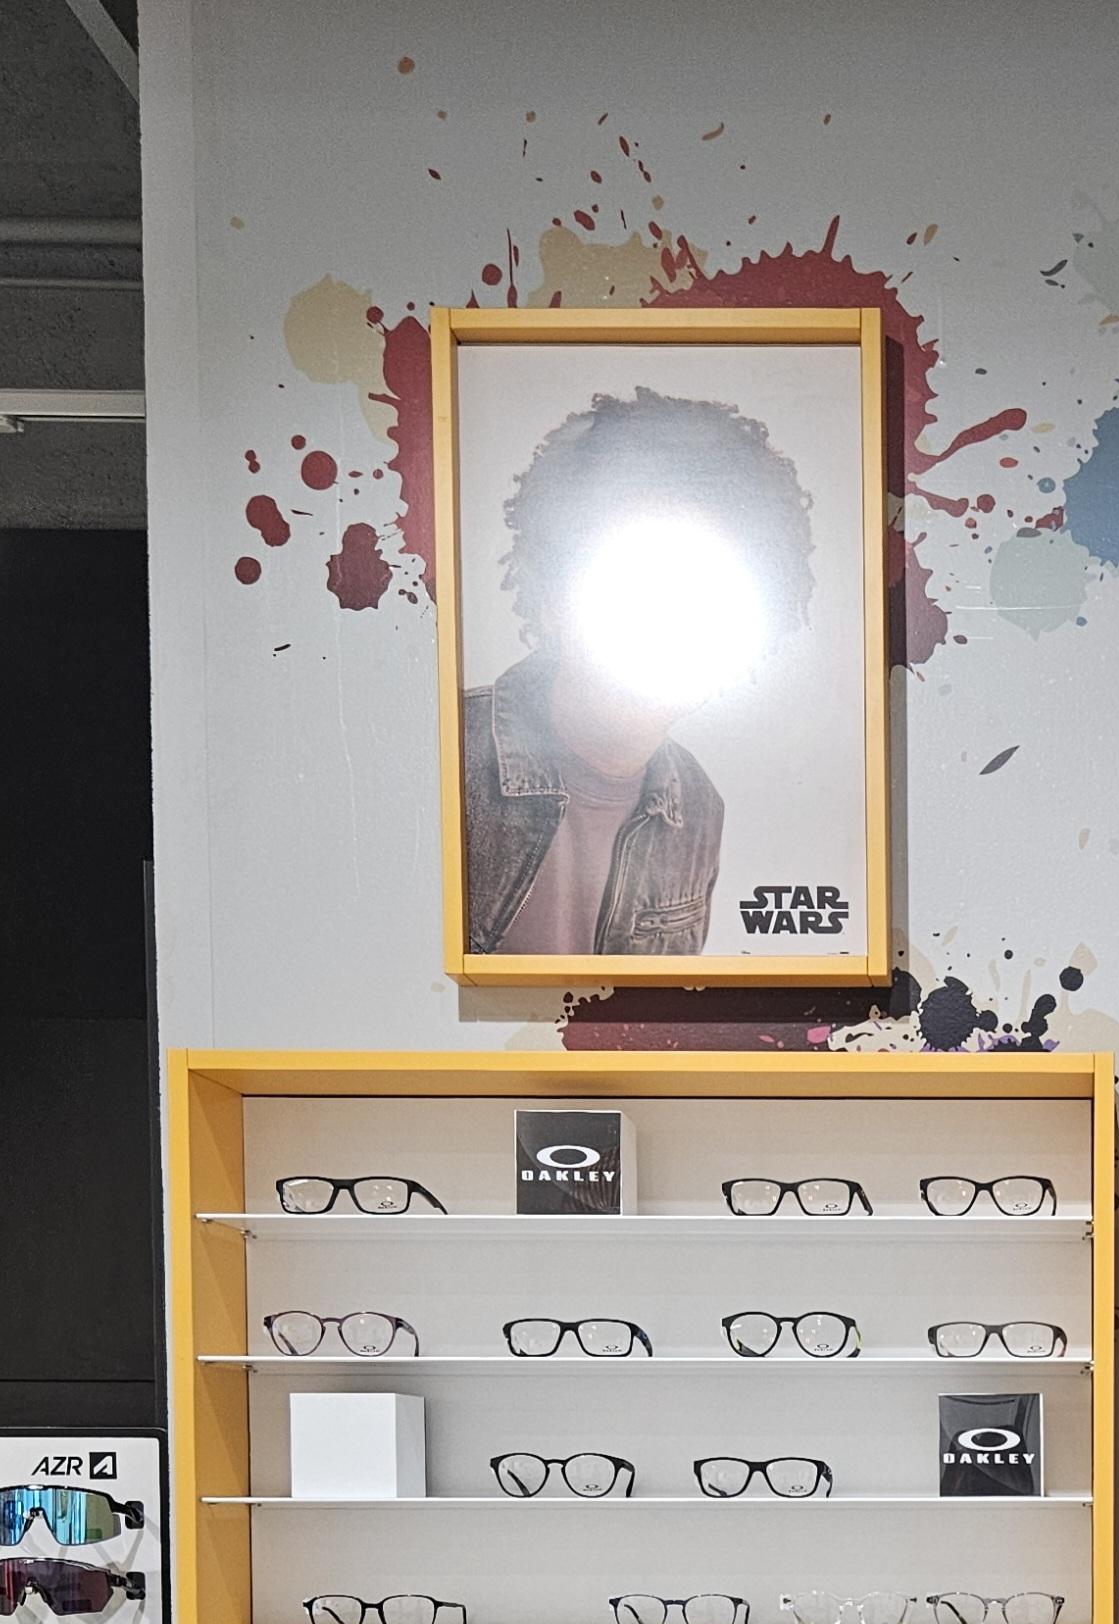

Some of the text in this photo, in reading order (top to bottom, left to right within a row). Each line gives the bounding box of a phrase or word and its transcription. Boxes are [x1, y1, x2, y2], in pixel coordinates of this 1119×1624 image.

[739, 886, 849, 909] STAR
[740, 911, 849, 934] WARS
[521, 1170, 615, 1182] OAKLEY
[31, 1456, 83, 1476] AZR
[943, 1453, 1035, 1464] OAKLEY
